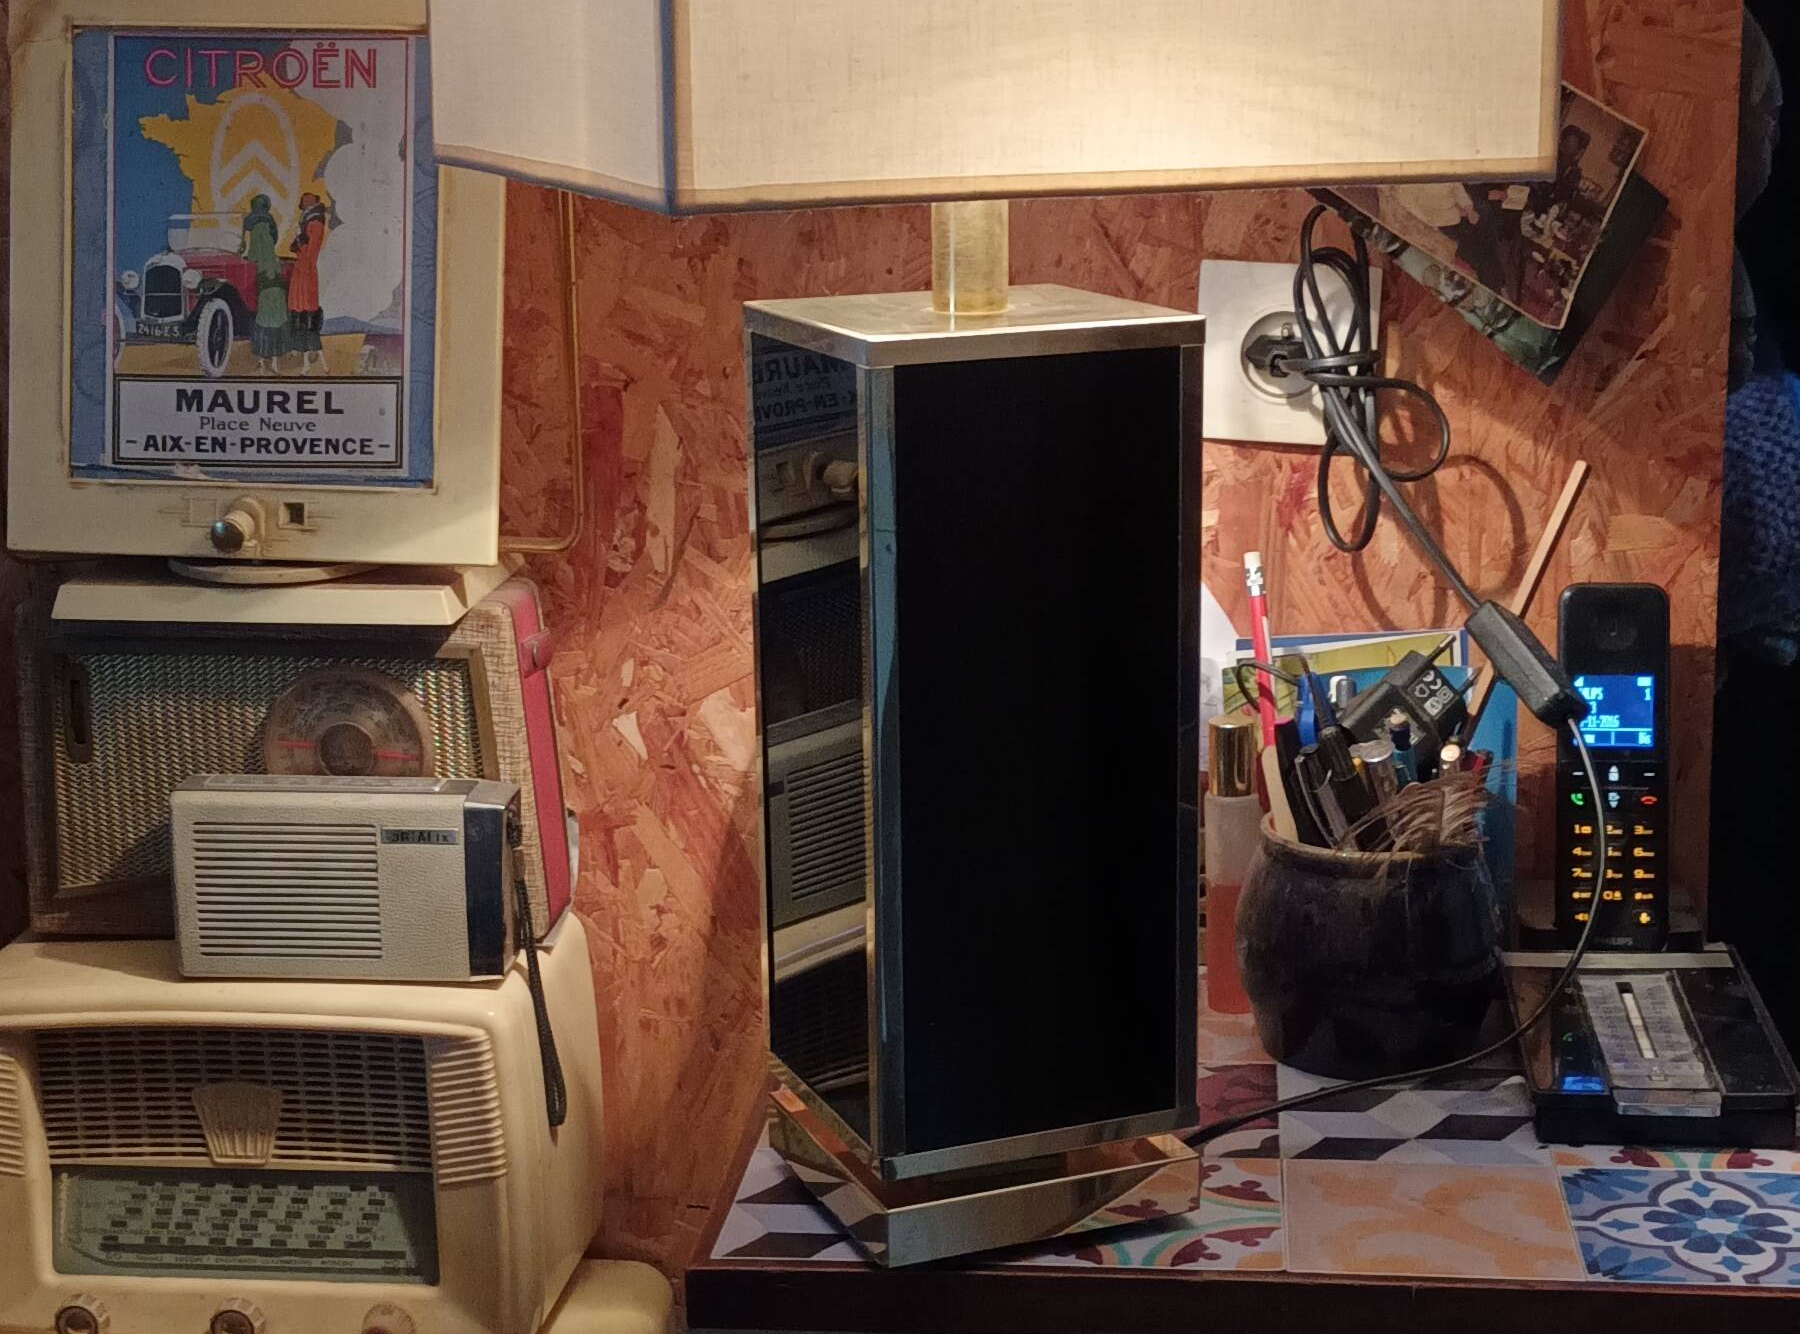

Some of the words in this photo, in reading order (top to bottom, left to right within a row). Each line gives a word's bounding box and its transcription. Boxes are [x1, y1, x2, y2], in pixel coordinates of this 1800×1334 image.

[144, 41, 377, 89] CITROËN
[176, 388, 344, 415] MAUREL
[200, 416, 250, 431] Place
[260, 417, 317, 432] Neuve
